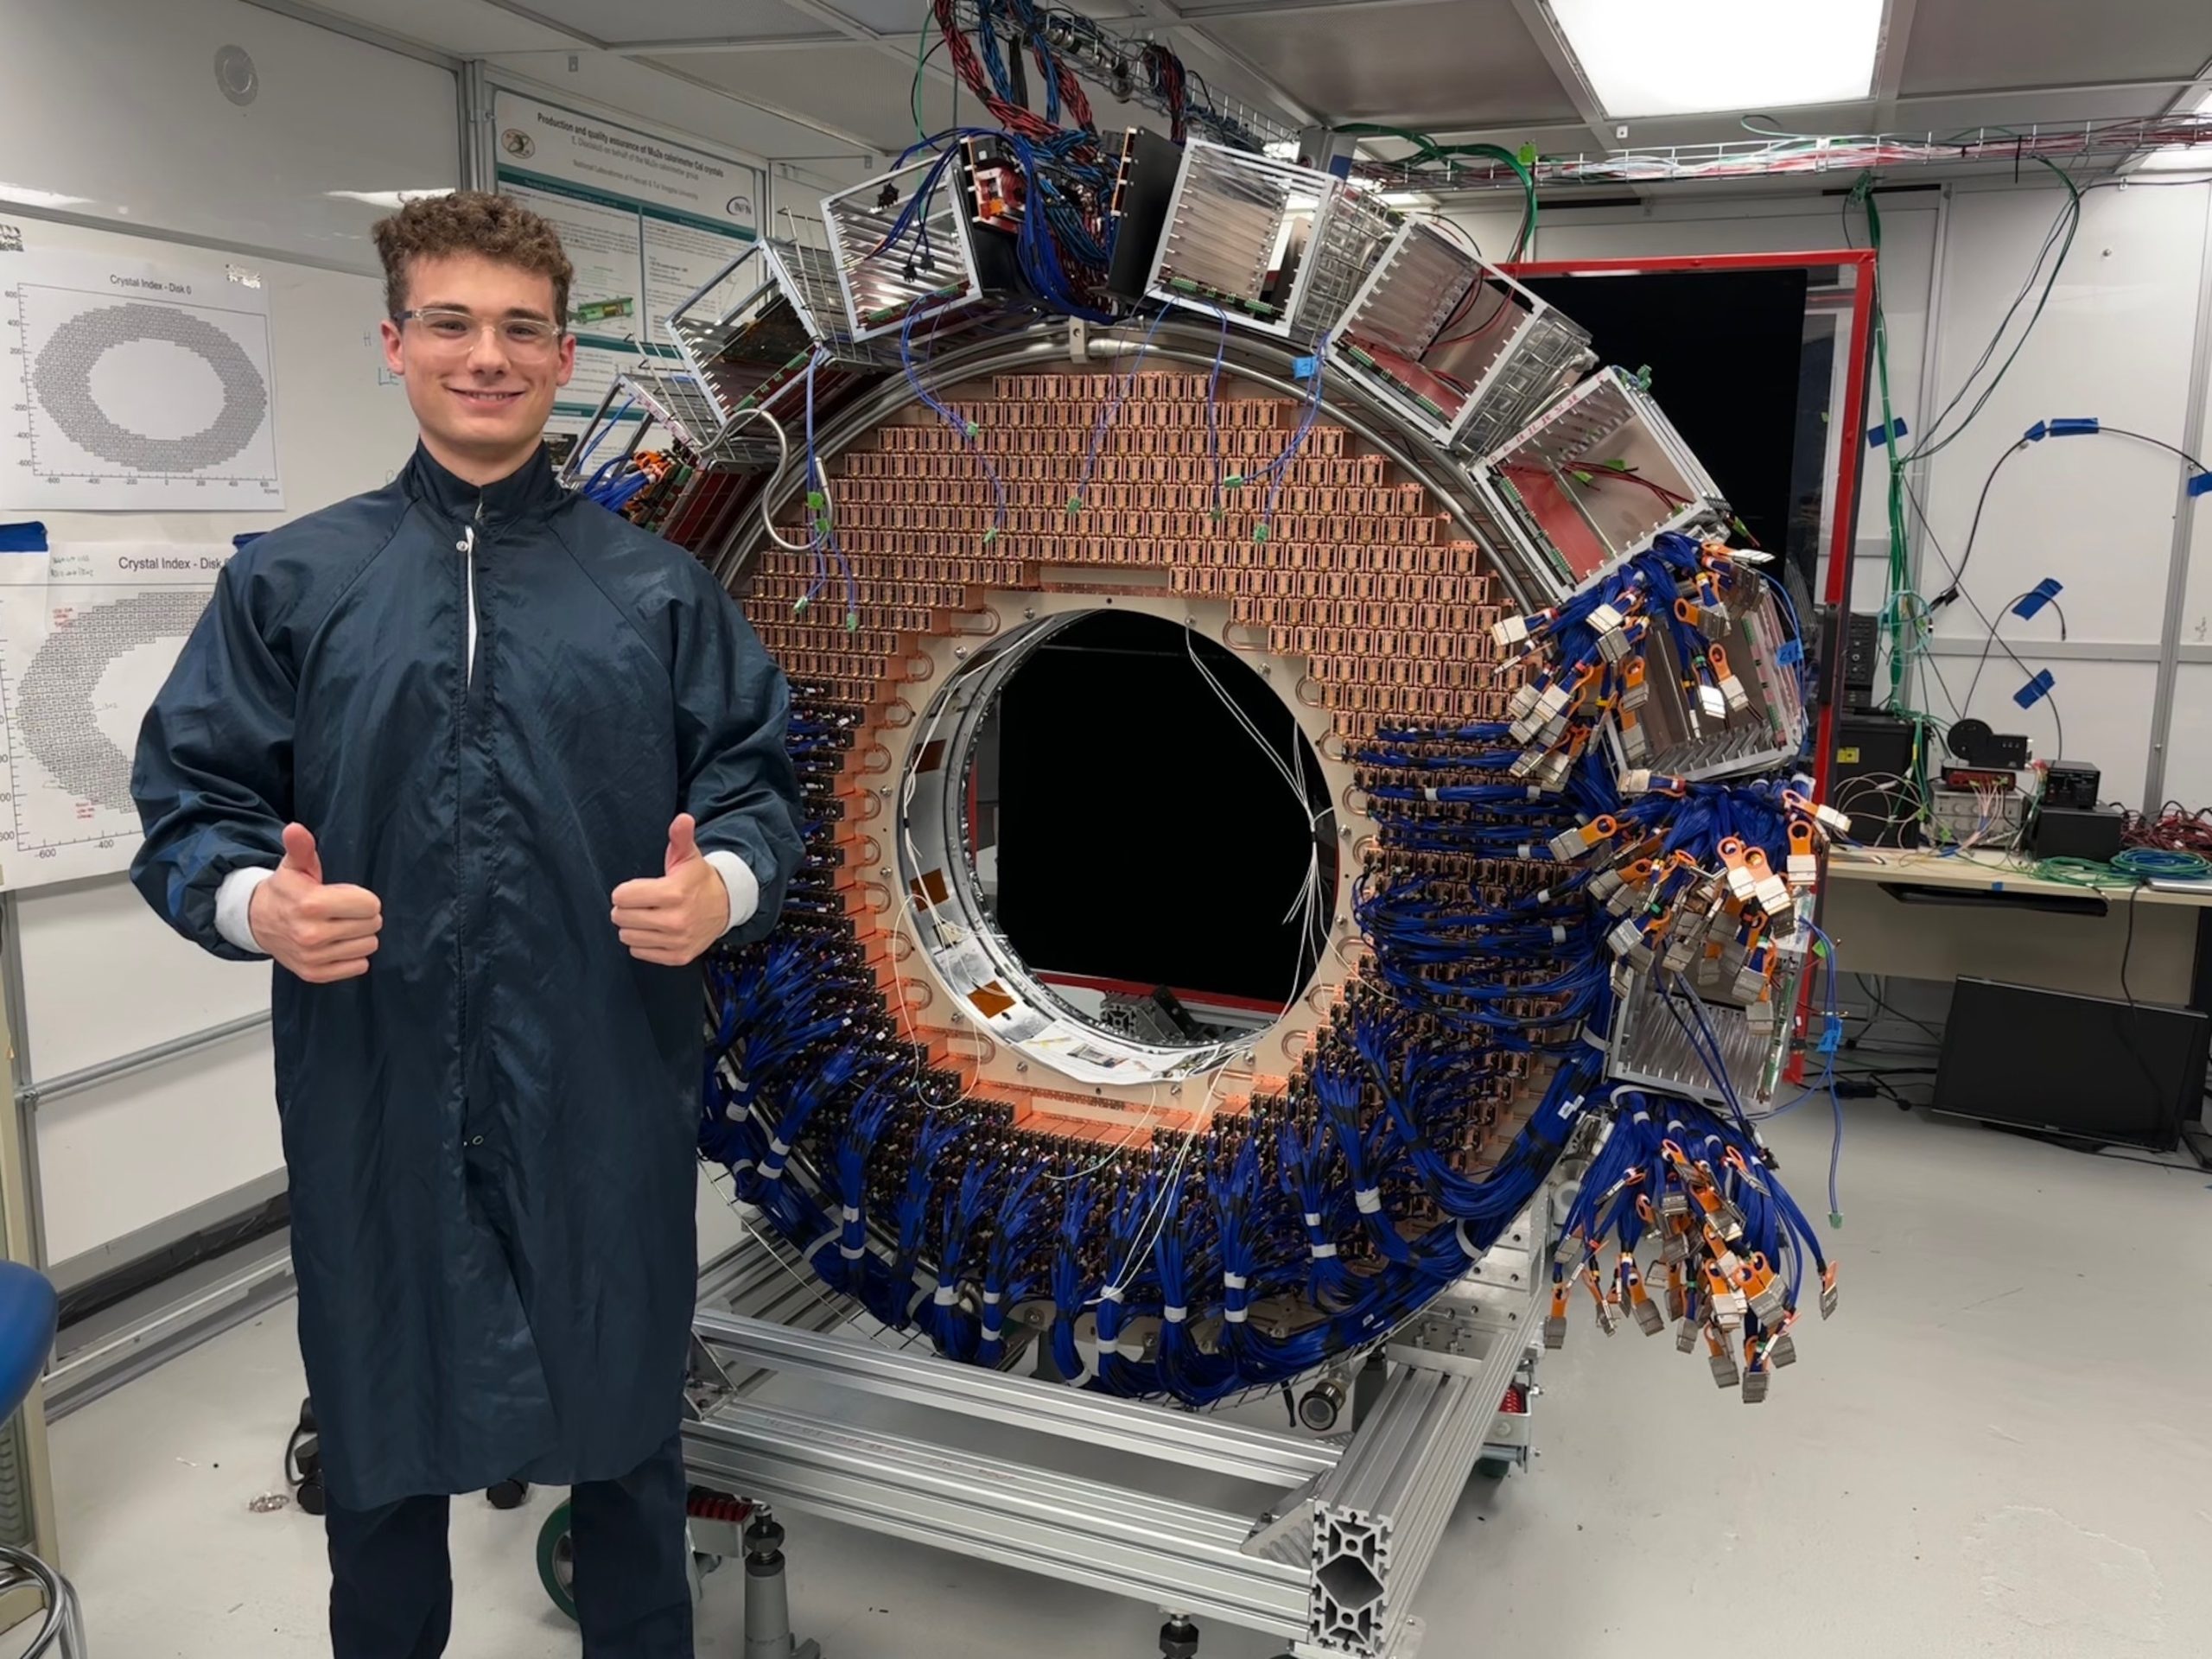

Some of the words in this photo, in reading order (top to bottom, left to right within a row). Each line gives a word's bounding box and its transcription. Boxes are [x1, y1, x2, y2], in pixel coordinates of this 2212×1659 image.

[537, 111, 574, 131] Production
[575, 126, 587, 136] and
[588, 130, 608, 144] quality
[609, 137, 639, 152] assurance
[640, 145, 647, 154] of
[664, 153, 694, 168] calorimeter
[704, 165, 724, 178] crystals
[110, 274, 139, 287] Crystal
[142, 278, 162, 290] Index
[169, 283, 184, 294] Disk
[118, 556, 159, 571] Crystal
[162, 557, 191, 569] Index
[200, 557, 221, 569] Disk
[93, 840, 114, 849] -400
[35, 849, 56, 859] -600
